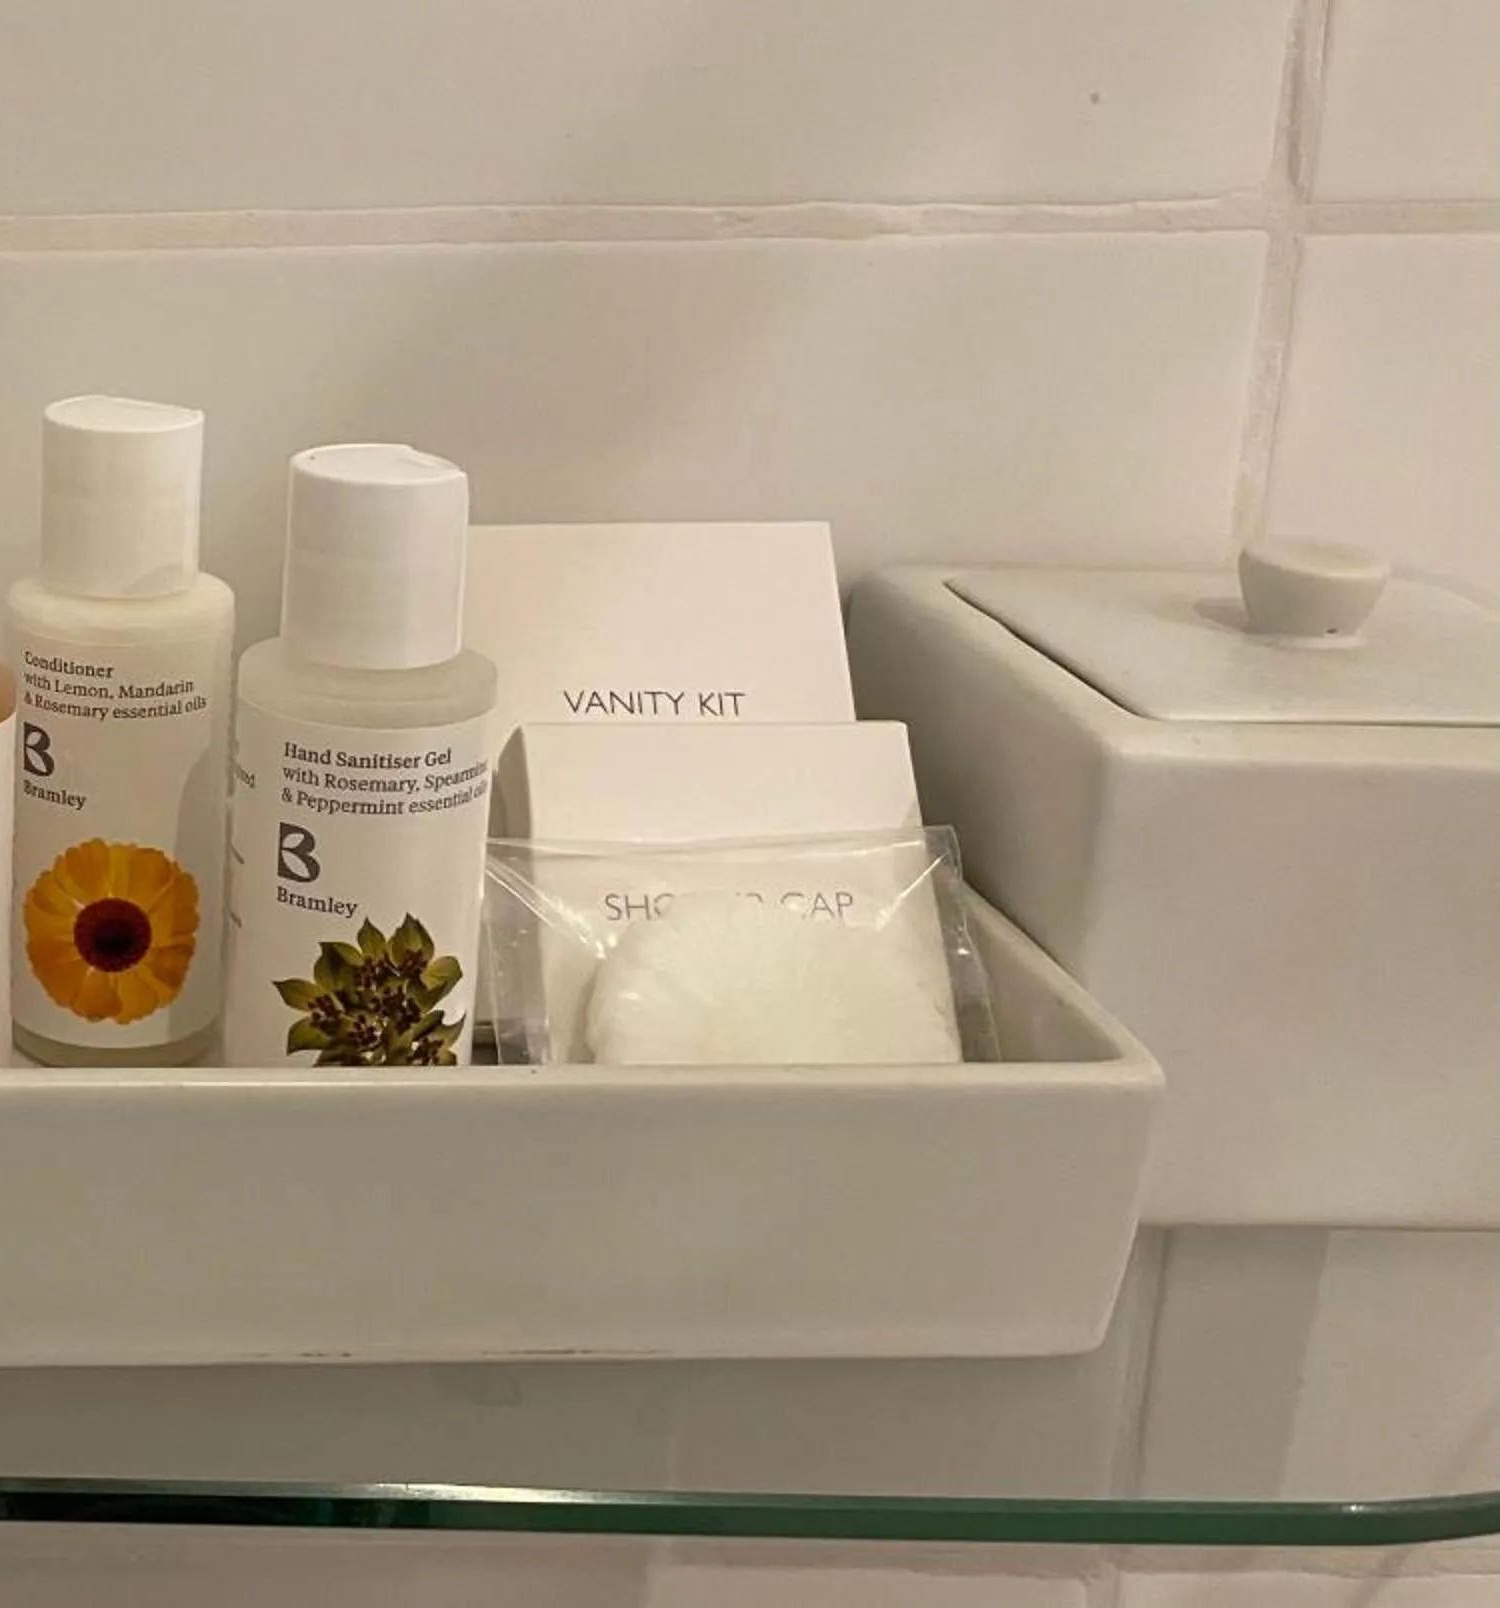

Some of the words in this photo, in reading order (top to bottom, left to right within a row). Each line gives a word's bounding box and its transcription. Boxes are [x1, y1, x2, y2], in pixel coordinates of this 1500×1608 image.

[25, 650, 114, 679] Conditioner
[23, 672, 51, 691] with
[54, 679, 114, 700] Lemon,
[118, 679, 194, 699] Mandarin
[35, 694, 109, 721] Rosemary
[112, 699, 182, 719] essential
[185, 696, 207, 713] oils
[564, 690, 684, 716] VANITY
[699, 692, 746, 716] KIT
[284, 741, 331, 766] Hand
[335, 750, 421, 769] Sanitiser
[425, 747, 452, 767] Gel
[283, 766, 319, 787] with
[325, 773, 420, 795] Rosemary,
[23, 780, 87, 811] Bramley
[281, 788, 292, 802] &
[297, 790, 404, 815] Peppermint
[409, 786, 472, 813] essential
[277, 886, 359, 918] Bramley
